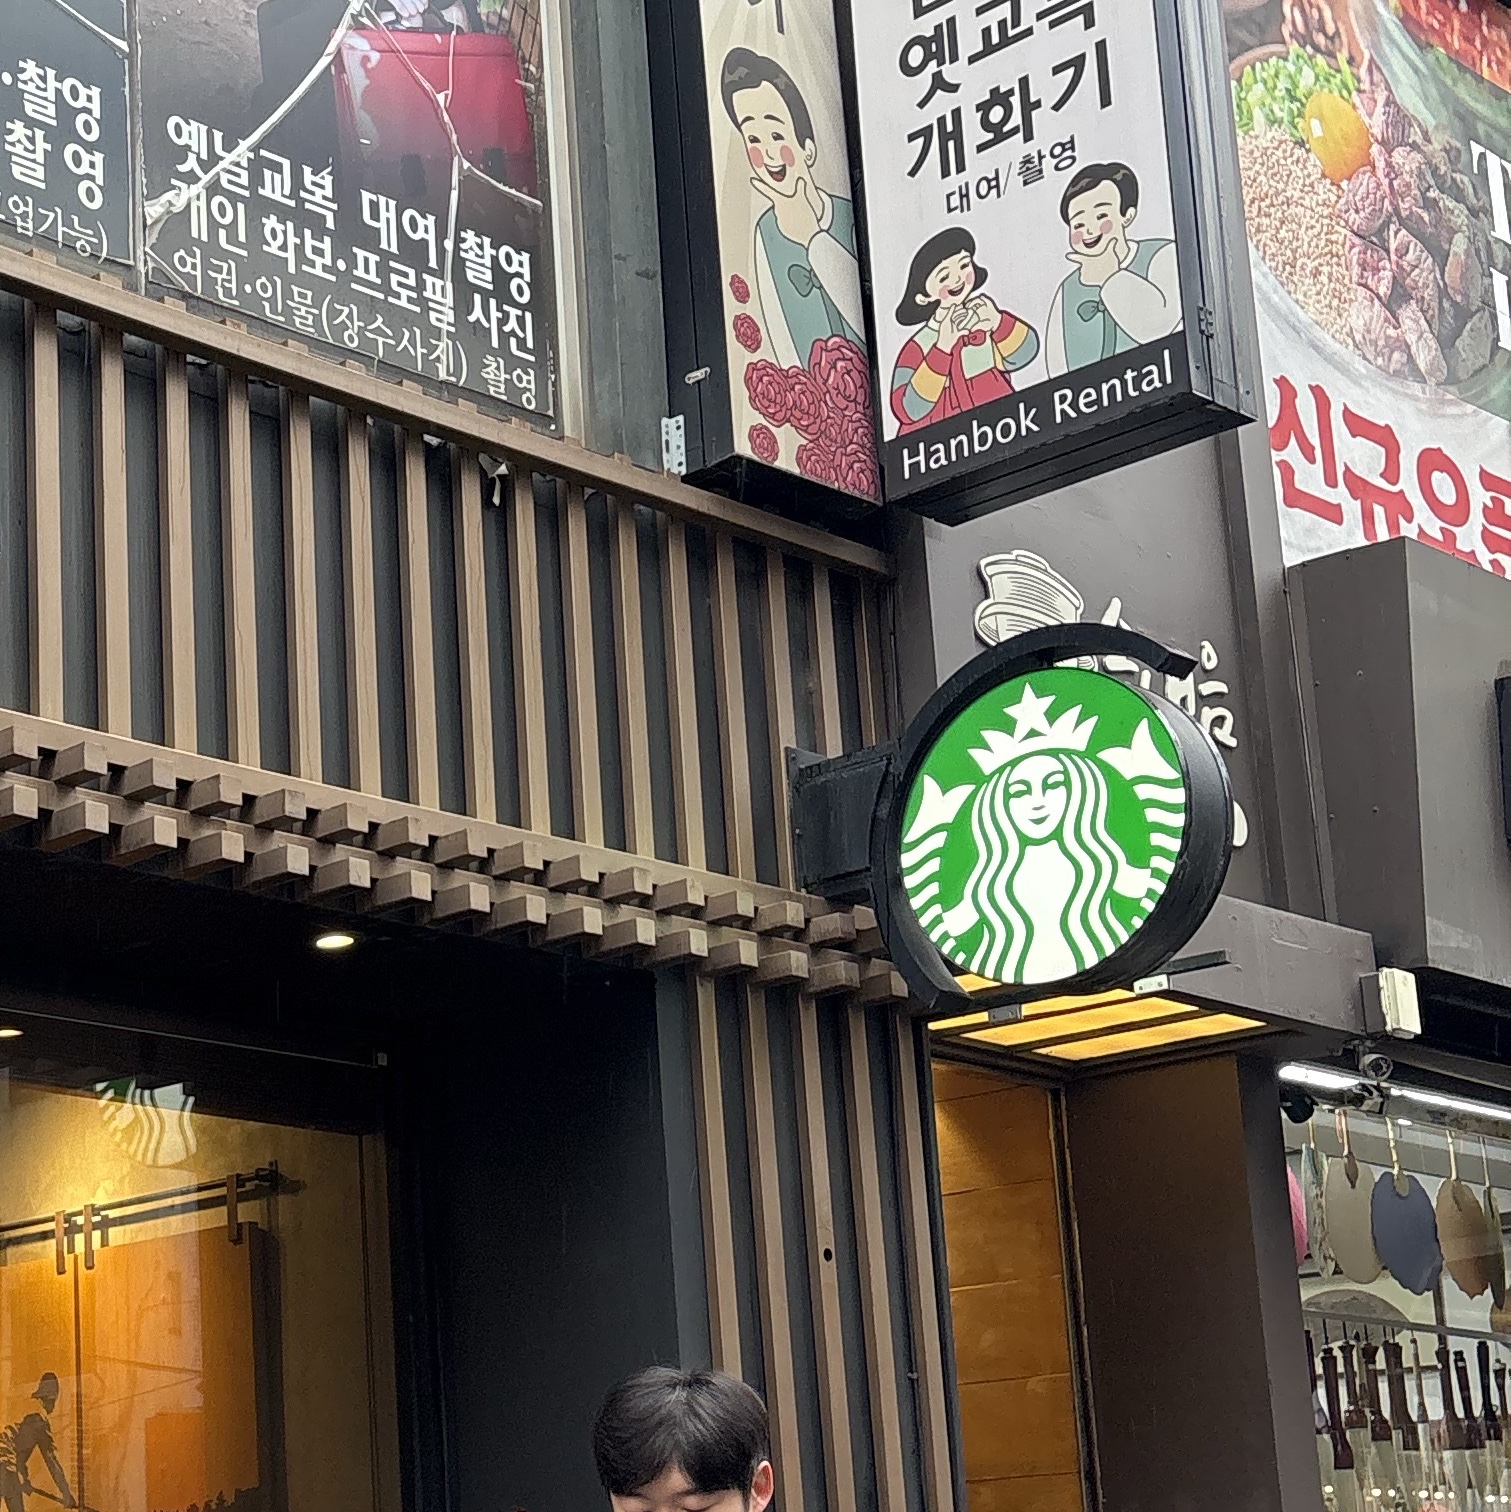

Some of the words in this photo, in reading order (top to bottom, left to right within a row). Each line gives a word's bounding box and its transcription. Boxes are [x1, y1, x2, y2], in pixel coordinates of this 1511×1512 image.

[907, 38, 1113, 180] 개화기
[5, 118, 105, 210] 촬영
[167, 115, 338, 230] 옛날교복
[467, 296, 536, 362] 사진
[481, 354, 537, 411] 촬영
[902, 404, 1040, 480] Hanbok
[1053, 348, 1174, 424] Rental
